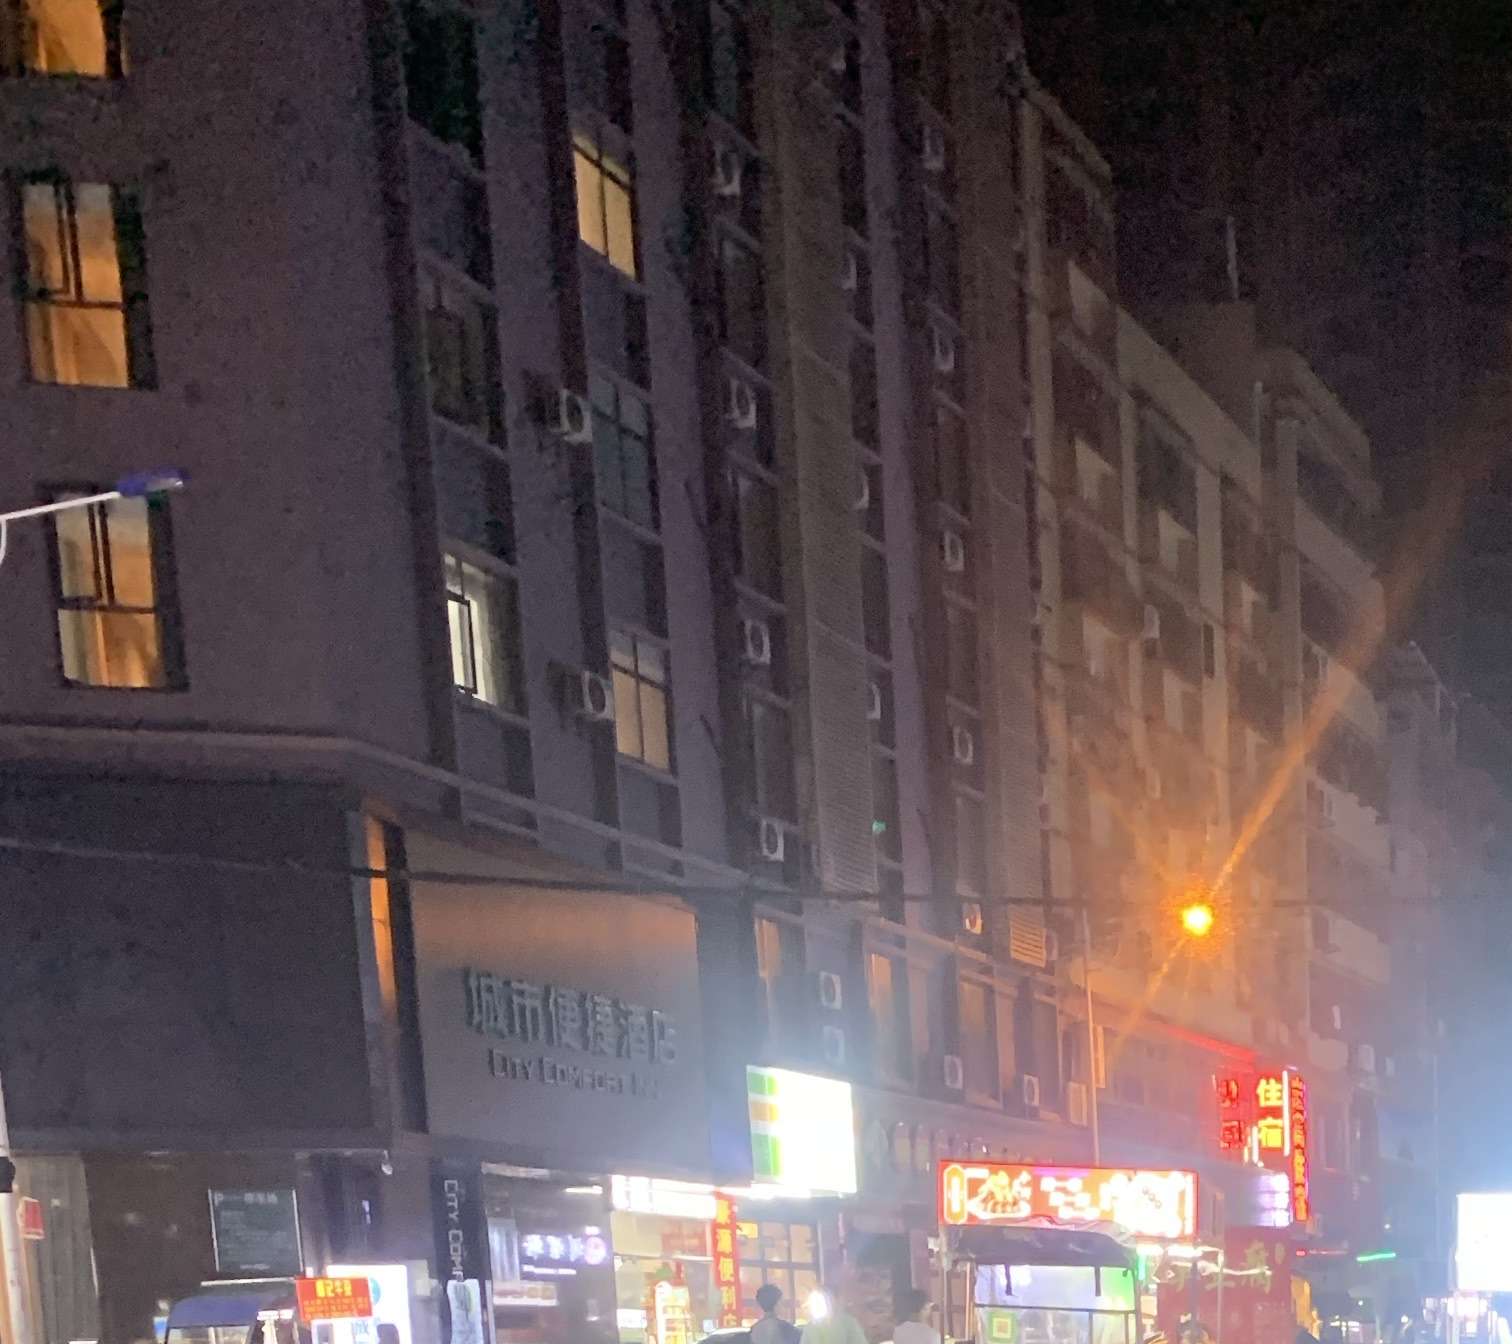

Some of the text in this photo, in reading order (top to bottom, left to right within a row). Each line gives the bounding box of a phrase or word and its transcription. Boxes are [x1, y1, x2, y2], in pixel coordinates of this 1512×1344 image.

[463, 967, 677, 1064] 城市便捷酒店
[488, 1048, 533, 1082] CITY
[1256, 1077, 1283, 1148] 住宿
[444, 1178, 459, 1225] CITY
